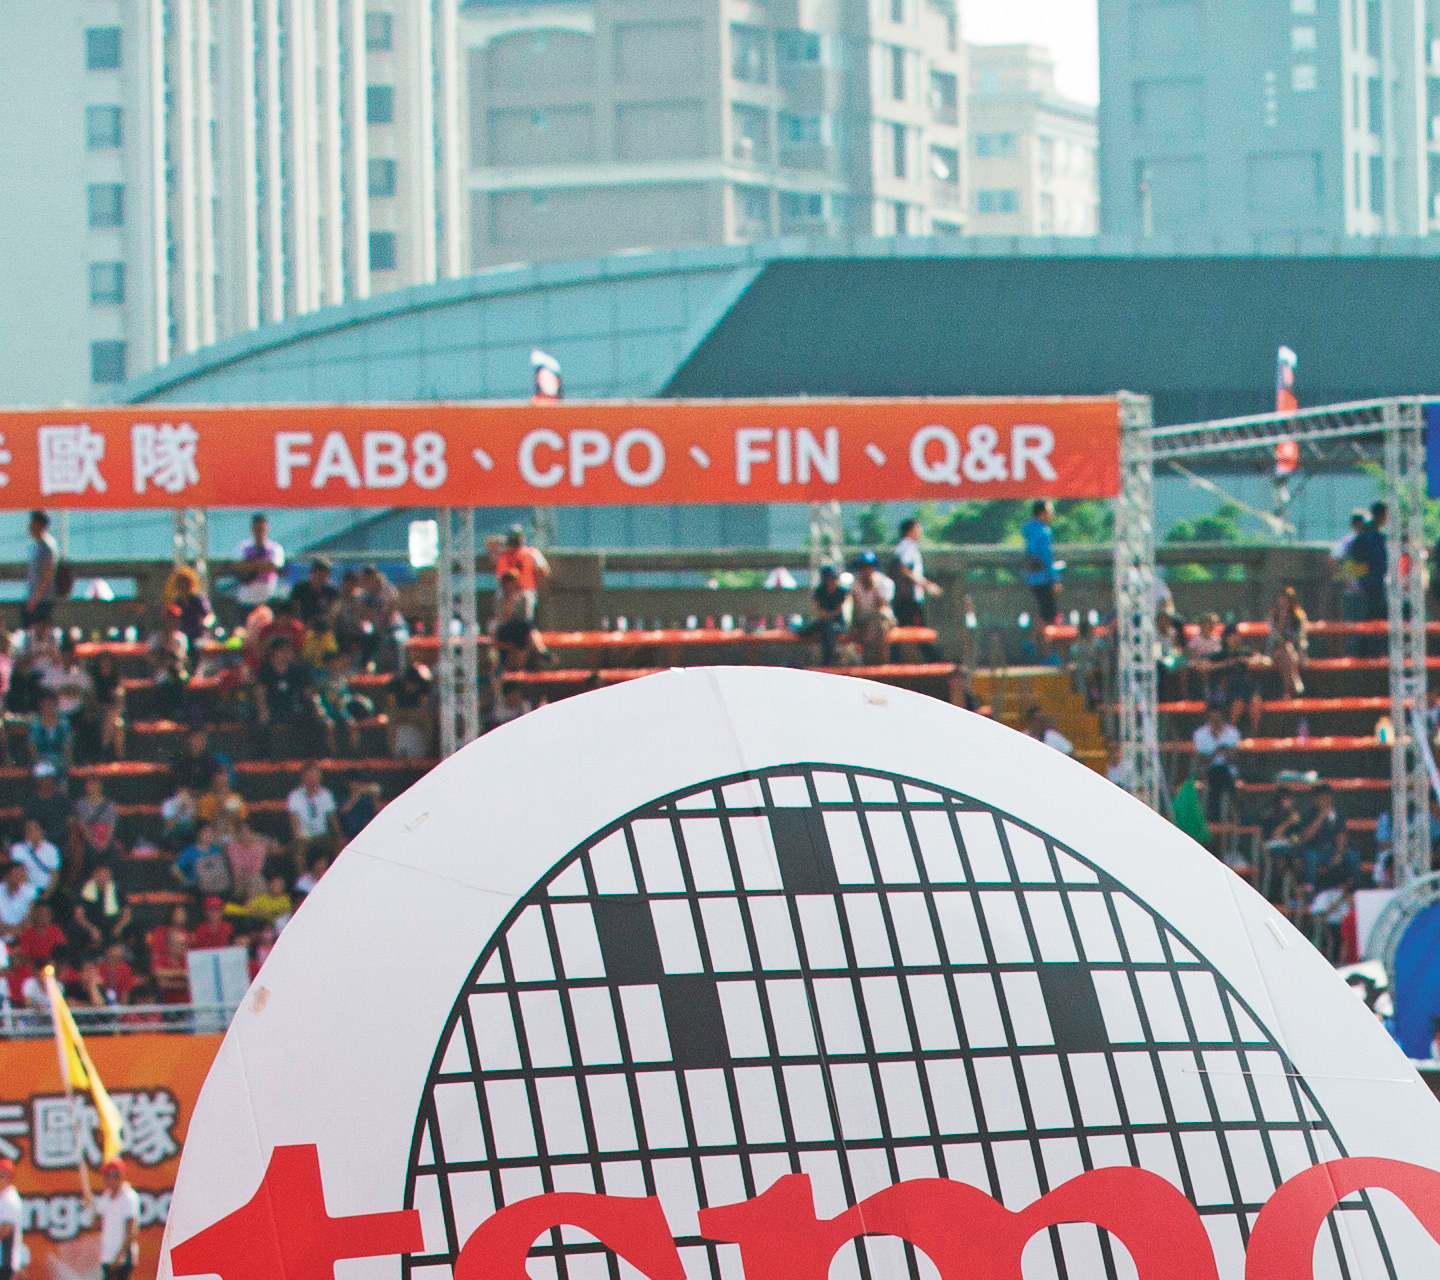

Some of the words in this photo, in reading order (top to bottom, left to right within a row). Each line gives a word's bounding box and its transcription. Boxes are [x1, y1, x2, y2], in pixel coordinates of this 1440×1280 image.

[274, 431, 448, 490] FAB8
[517, 427, 667, 488] CPO
[734, 427, 841, 485] FIN
[908, 424, 1059, 485] Q&R
